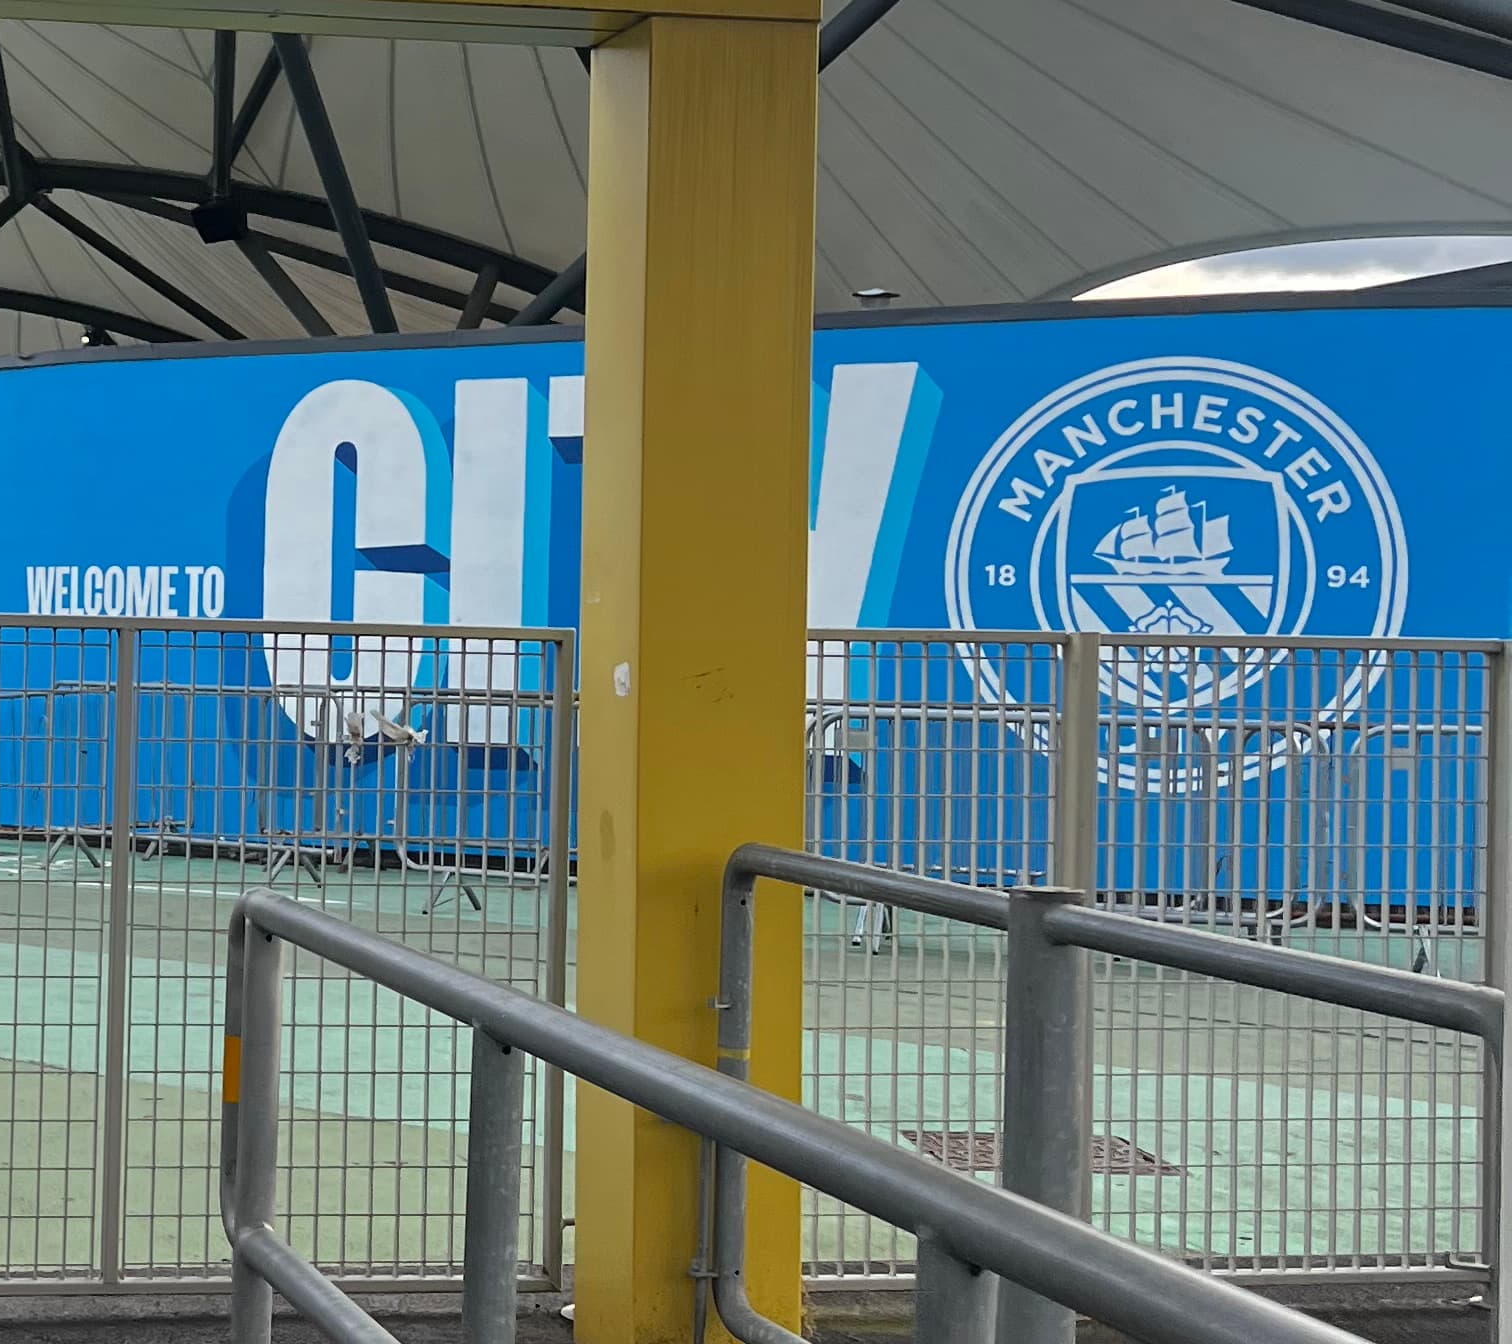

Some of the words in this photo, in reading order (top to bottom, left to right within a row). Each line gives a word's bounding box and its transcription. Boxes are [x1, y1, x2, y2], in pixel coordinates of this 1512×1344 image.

[997, 392, 1352, 523] MANCHESTER
[26, 565, 179, 617] WELCOME
[185, 565, 225, 618] TO
[985, 564, 1017, 587] 18
[1326, 564, 1370, 589] 94
